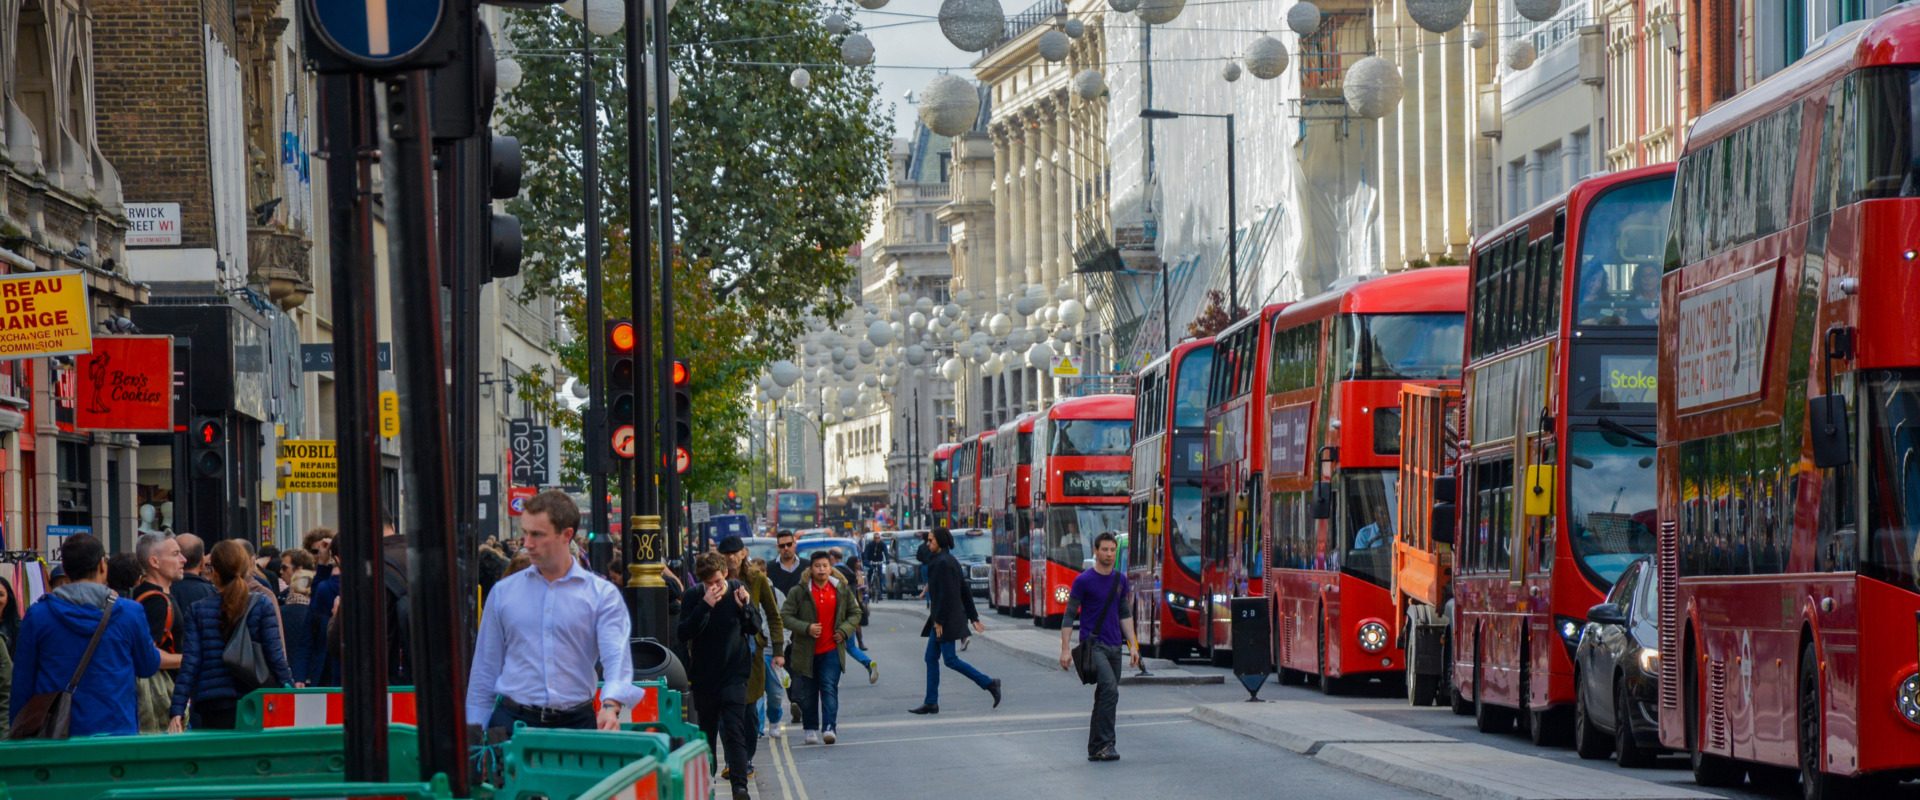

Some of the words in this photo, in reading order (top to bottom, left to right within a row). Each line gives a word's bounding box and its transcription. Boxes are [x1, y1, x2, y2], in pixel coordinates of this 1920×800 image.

[128, 207, 165, 218] RWICK
[130, 220, 154, 231] REET
[159, 220, 174, 231] W1
[1, 277, 63, 298] REAU
[4, 297, 36, 314] DE
[1610, 369, 1658, 389] Stoke
[111, 386, 161, 403] Cookies
[513, 421, 531, 477] next
[532, 429, 546, 481] next
[294, 471, 337, 479] UNLOCKIN
[1070, 477, 1098, 490] King's
[289, 481, 337, 489] ACCESSORI
